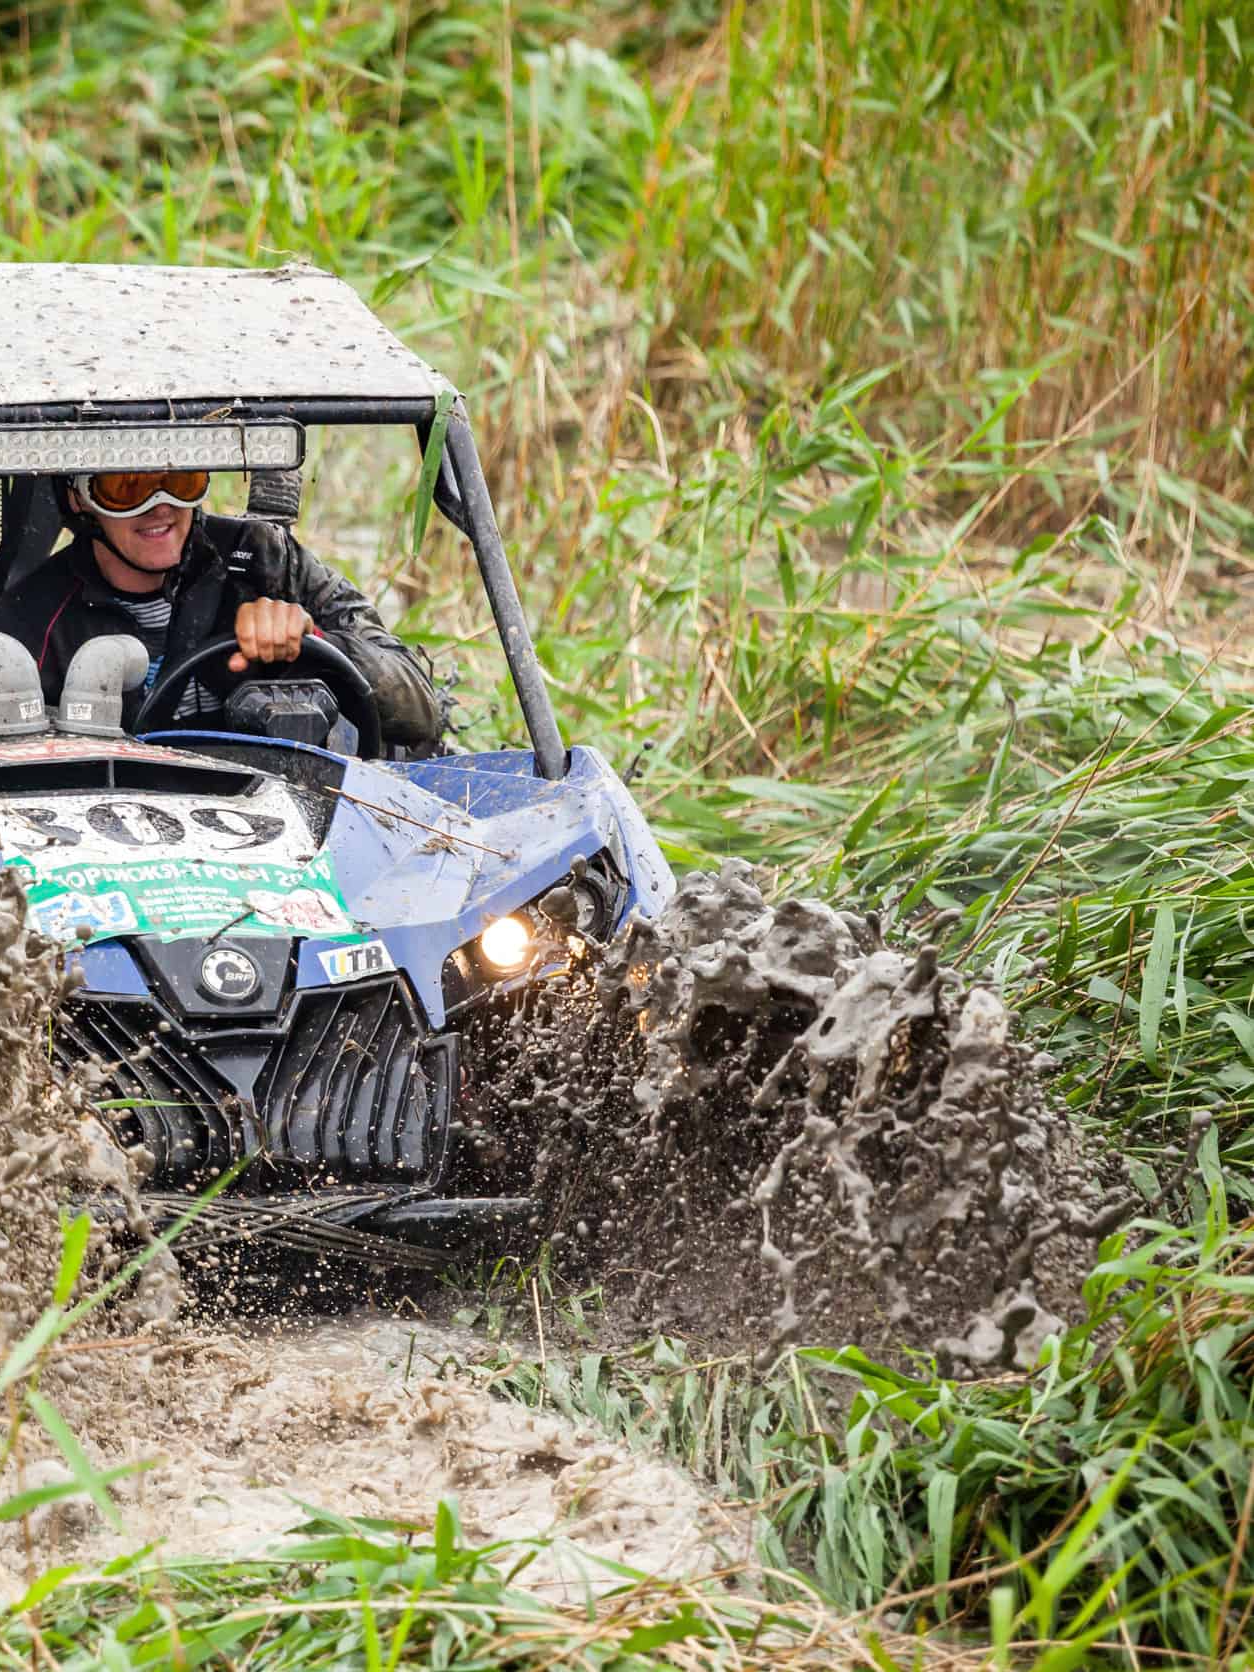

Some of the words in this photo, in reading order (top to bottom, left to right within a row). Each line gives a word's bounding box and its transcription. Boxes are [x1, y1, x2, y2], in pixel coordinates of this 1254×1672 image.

[7, 802, 286, 852] 309
[225, 971, 252, 982] BRP
[330, 946, 383, 977] UTR
